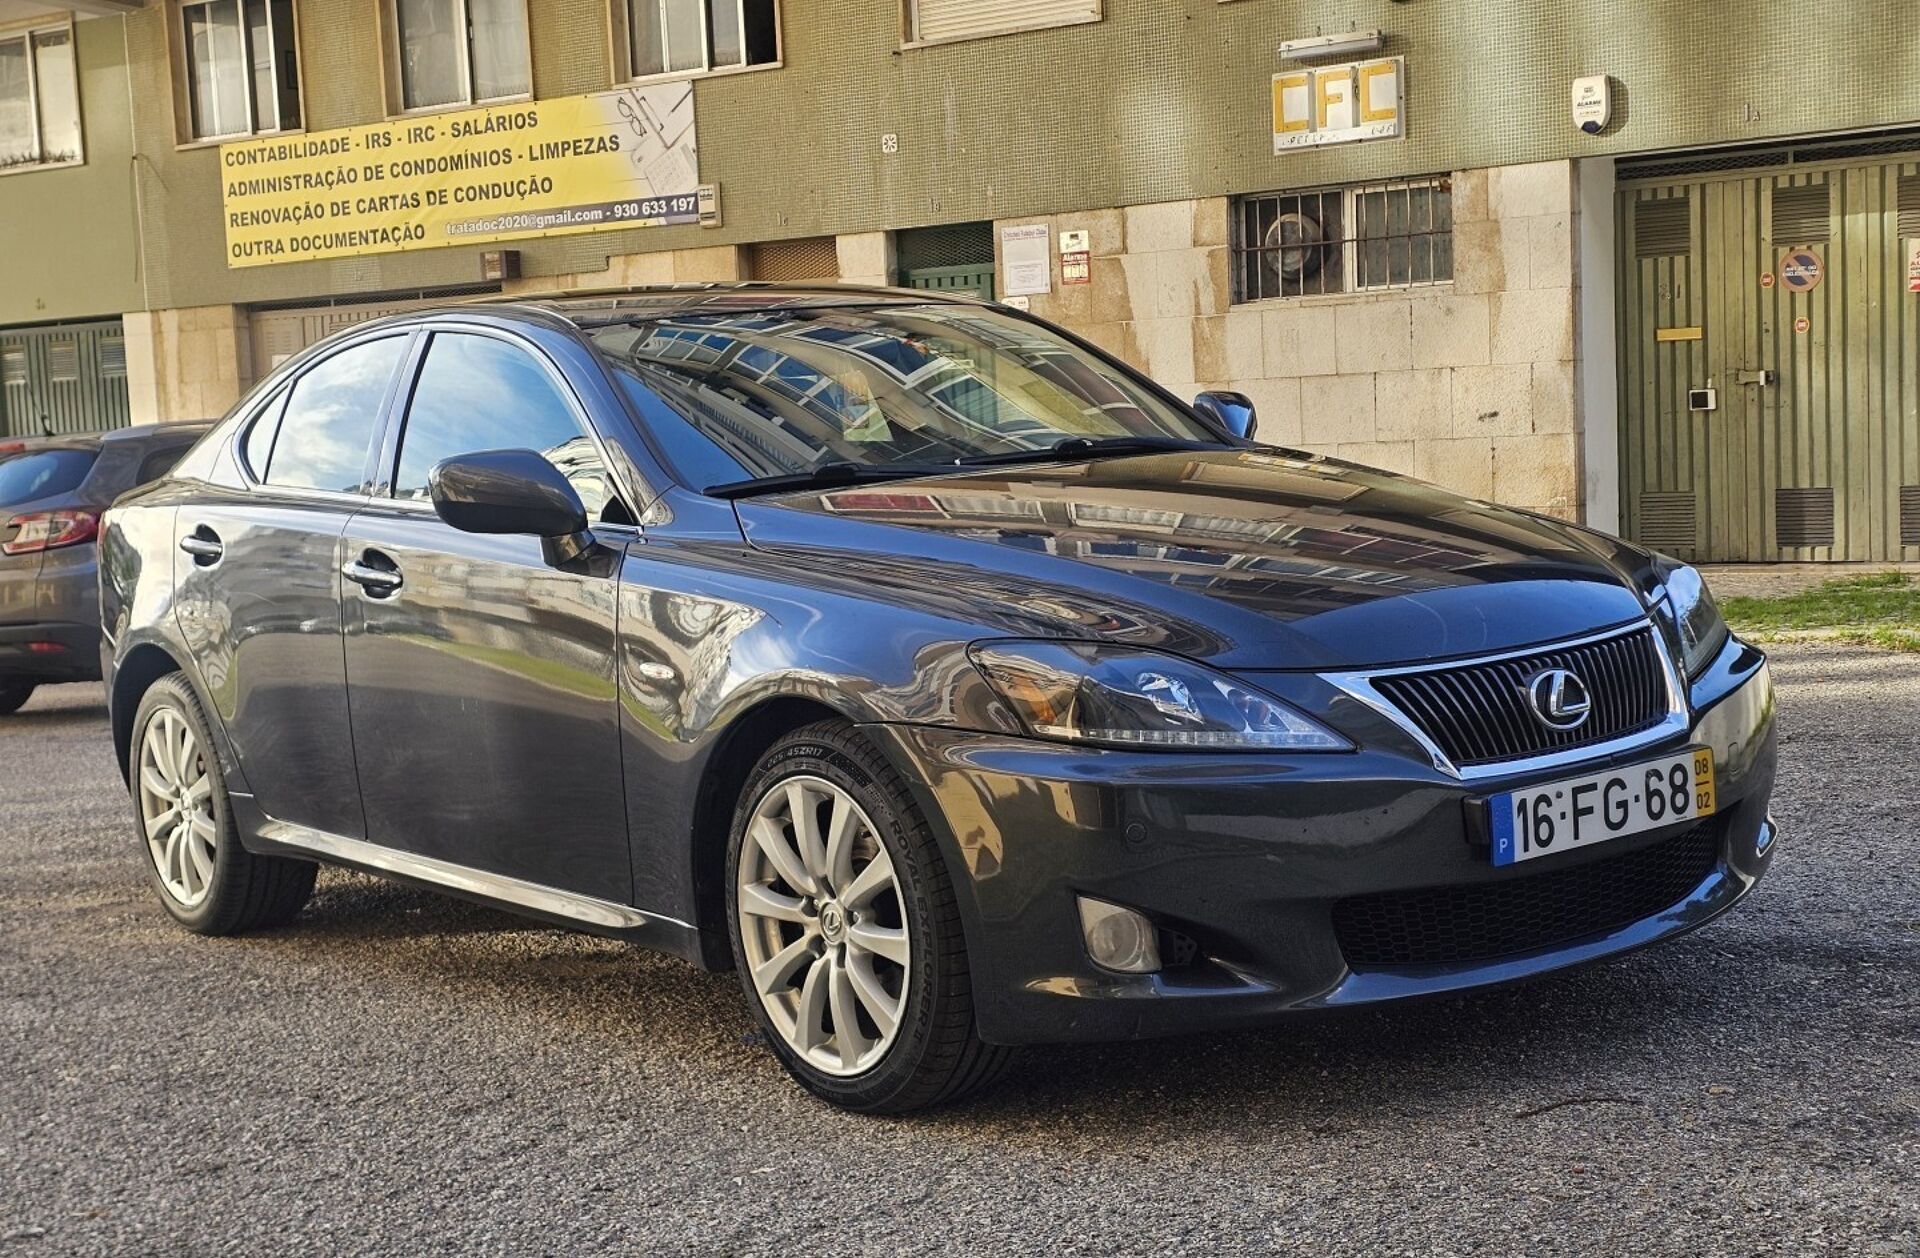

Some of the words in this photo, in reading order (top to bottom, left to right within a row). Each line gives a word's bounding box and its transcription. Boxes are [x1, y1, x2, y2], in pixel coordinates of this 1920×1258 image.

[1274, 63, 1396, 133] CFC
[226, 136, 350, 167] CONTABILIDADE
[365, 131, 392, 149] IRS
[407, 125, 435, 144] IRC
[451, 111, 538, 138] SALÁRIOS
[227, 166, 358, 197] ADMINISTRAÇÃO
[363, 164, 384, 182] DE
[390, 148, 512, 178] CONDOMÍNIOS
[529, 134, 620, 162] LIMPEZAS
[230, 201, 324, 228] RENOVAÇÃO
[330, 200, 350, 217] DE
[356, 192, 421, 214] CARTAS
[426, 189, 448, 206] DE
[454, 175, 553, 203] CONDUÇÃO
[447, 209, 603, 235] tratadoc2020@gmail.com
[614, 203, 638, 217] 930
[642, 200, 667, 215] 633
[670, 196, 696, 212] 197
[232, 238, 285, 258] OUTRA
[290, 222, 425, 252] DOCUMENTAÇÃO
[1694, 757, 1709, 776] 08
[1696, 791, 1711, 810] 02
[1500, 838, 1508, 853] P
[889, 819, 922, 892] ROYAL
[917, 896, 937, 1025] EXPLORER
